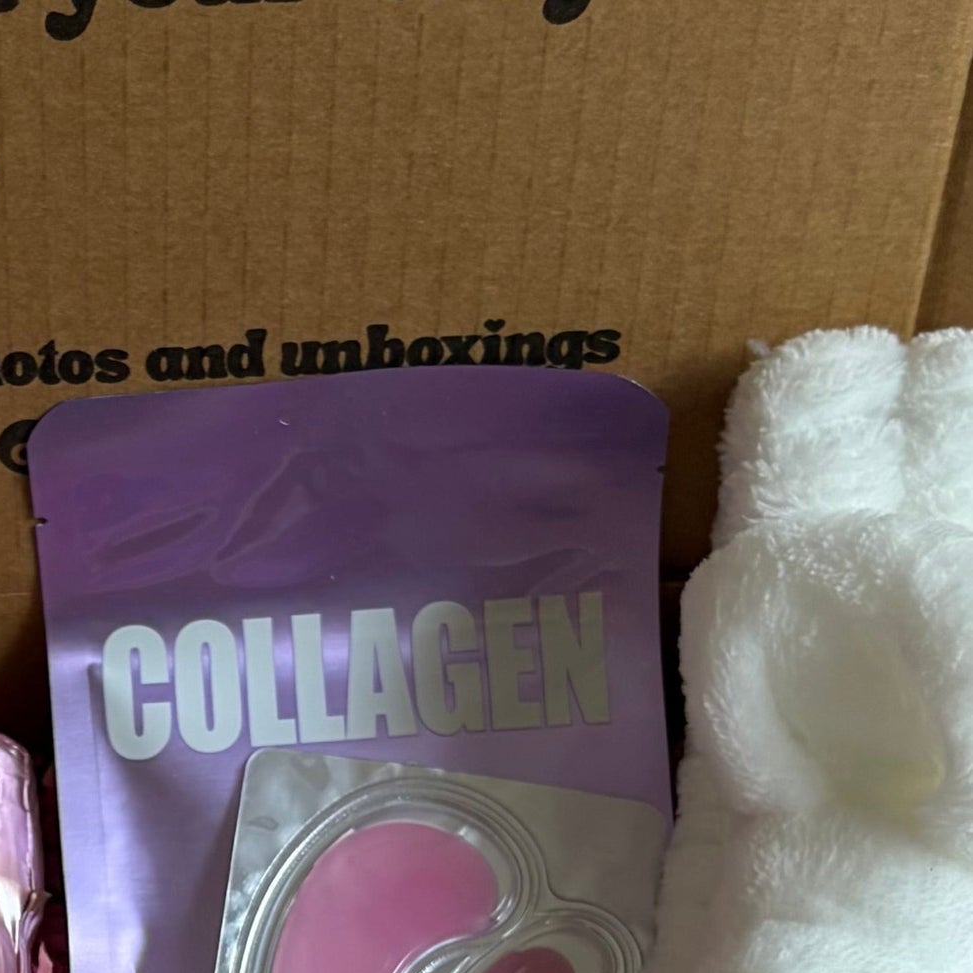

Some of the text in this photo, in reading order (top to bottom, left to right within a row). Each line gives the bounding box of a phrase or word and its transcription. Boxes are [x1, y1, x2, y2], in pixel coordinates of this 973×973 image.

[146, 329, 267, 382] and
[281, 319, 622, 376] unboxings
[102, 592, 612, 760] COLLAGEN
